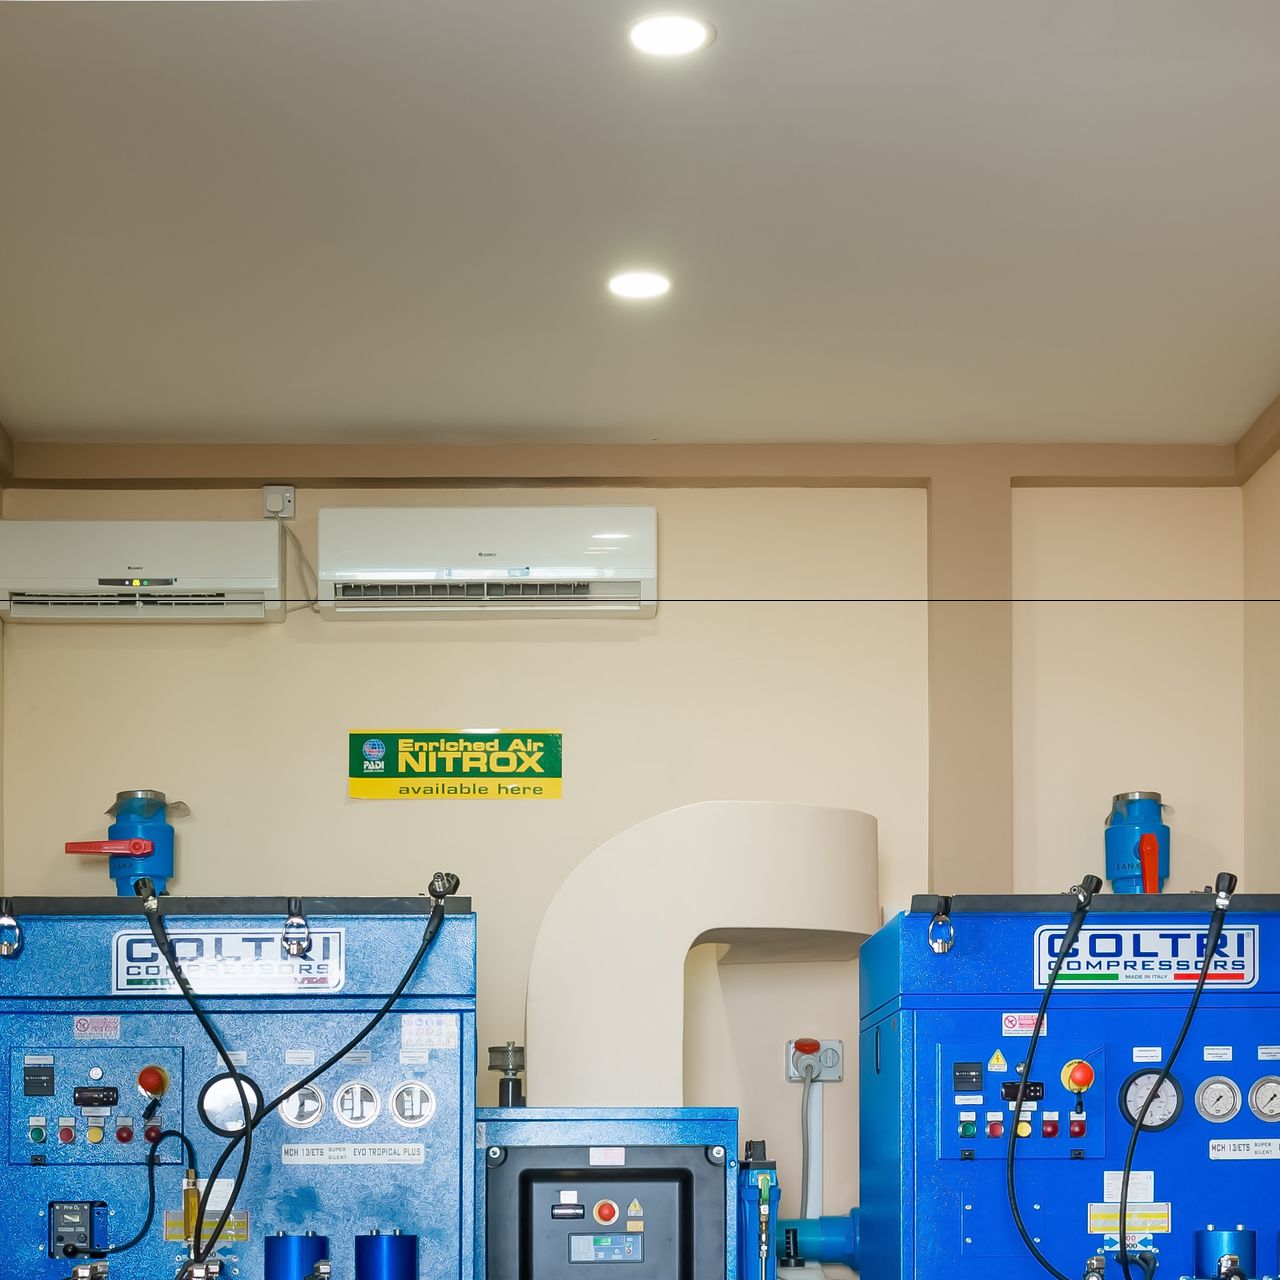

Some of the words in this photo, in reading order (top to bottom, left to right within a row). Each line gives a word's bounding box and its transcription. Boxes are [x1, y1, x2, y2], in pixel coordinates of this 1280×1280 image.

[398, 738, 499, 752] Enriched
[507, 738, 544, 752] Air
[363, 760, 385, 770] PADI
[398, 751, 545, 773] NITROX
[398, 783, 489, 795] available
[497, 783, 544, 795] here
[369, 1148, 401, 1156] TROPICAL
[402, 1147, 421, 1156] PLUS
